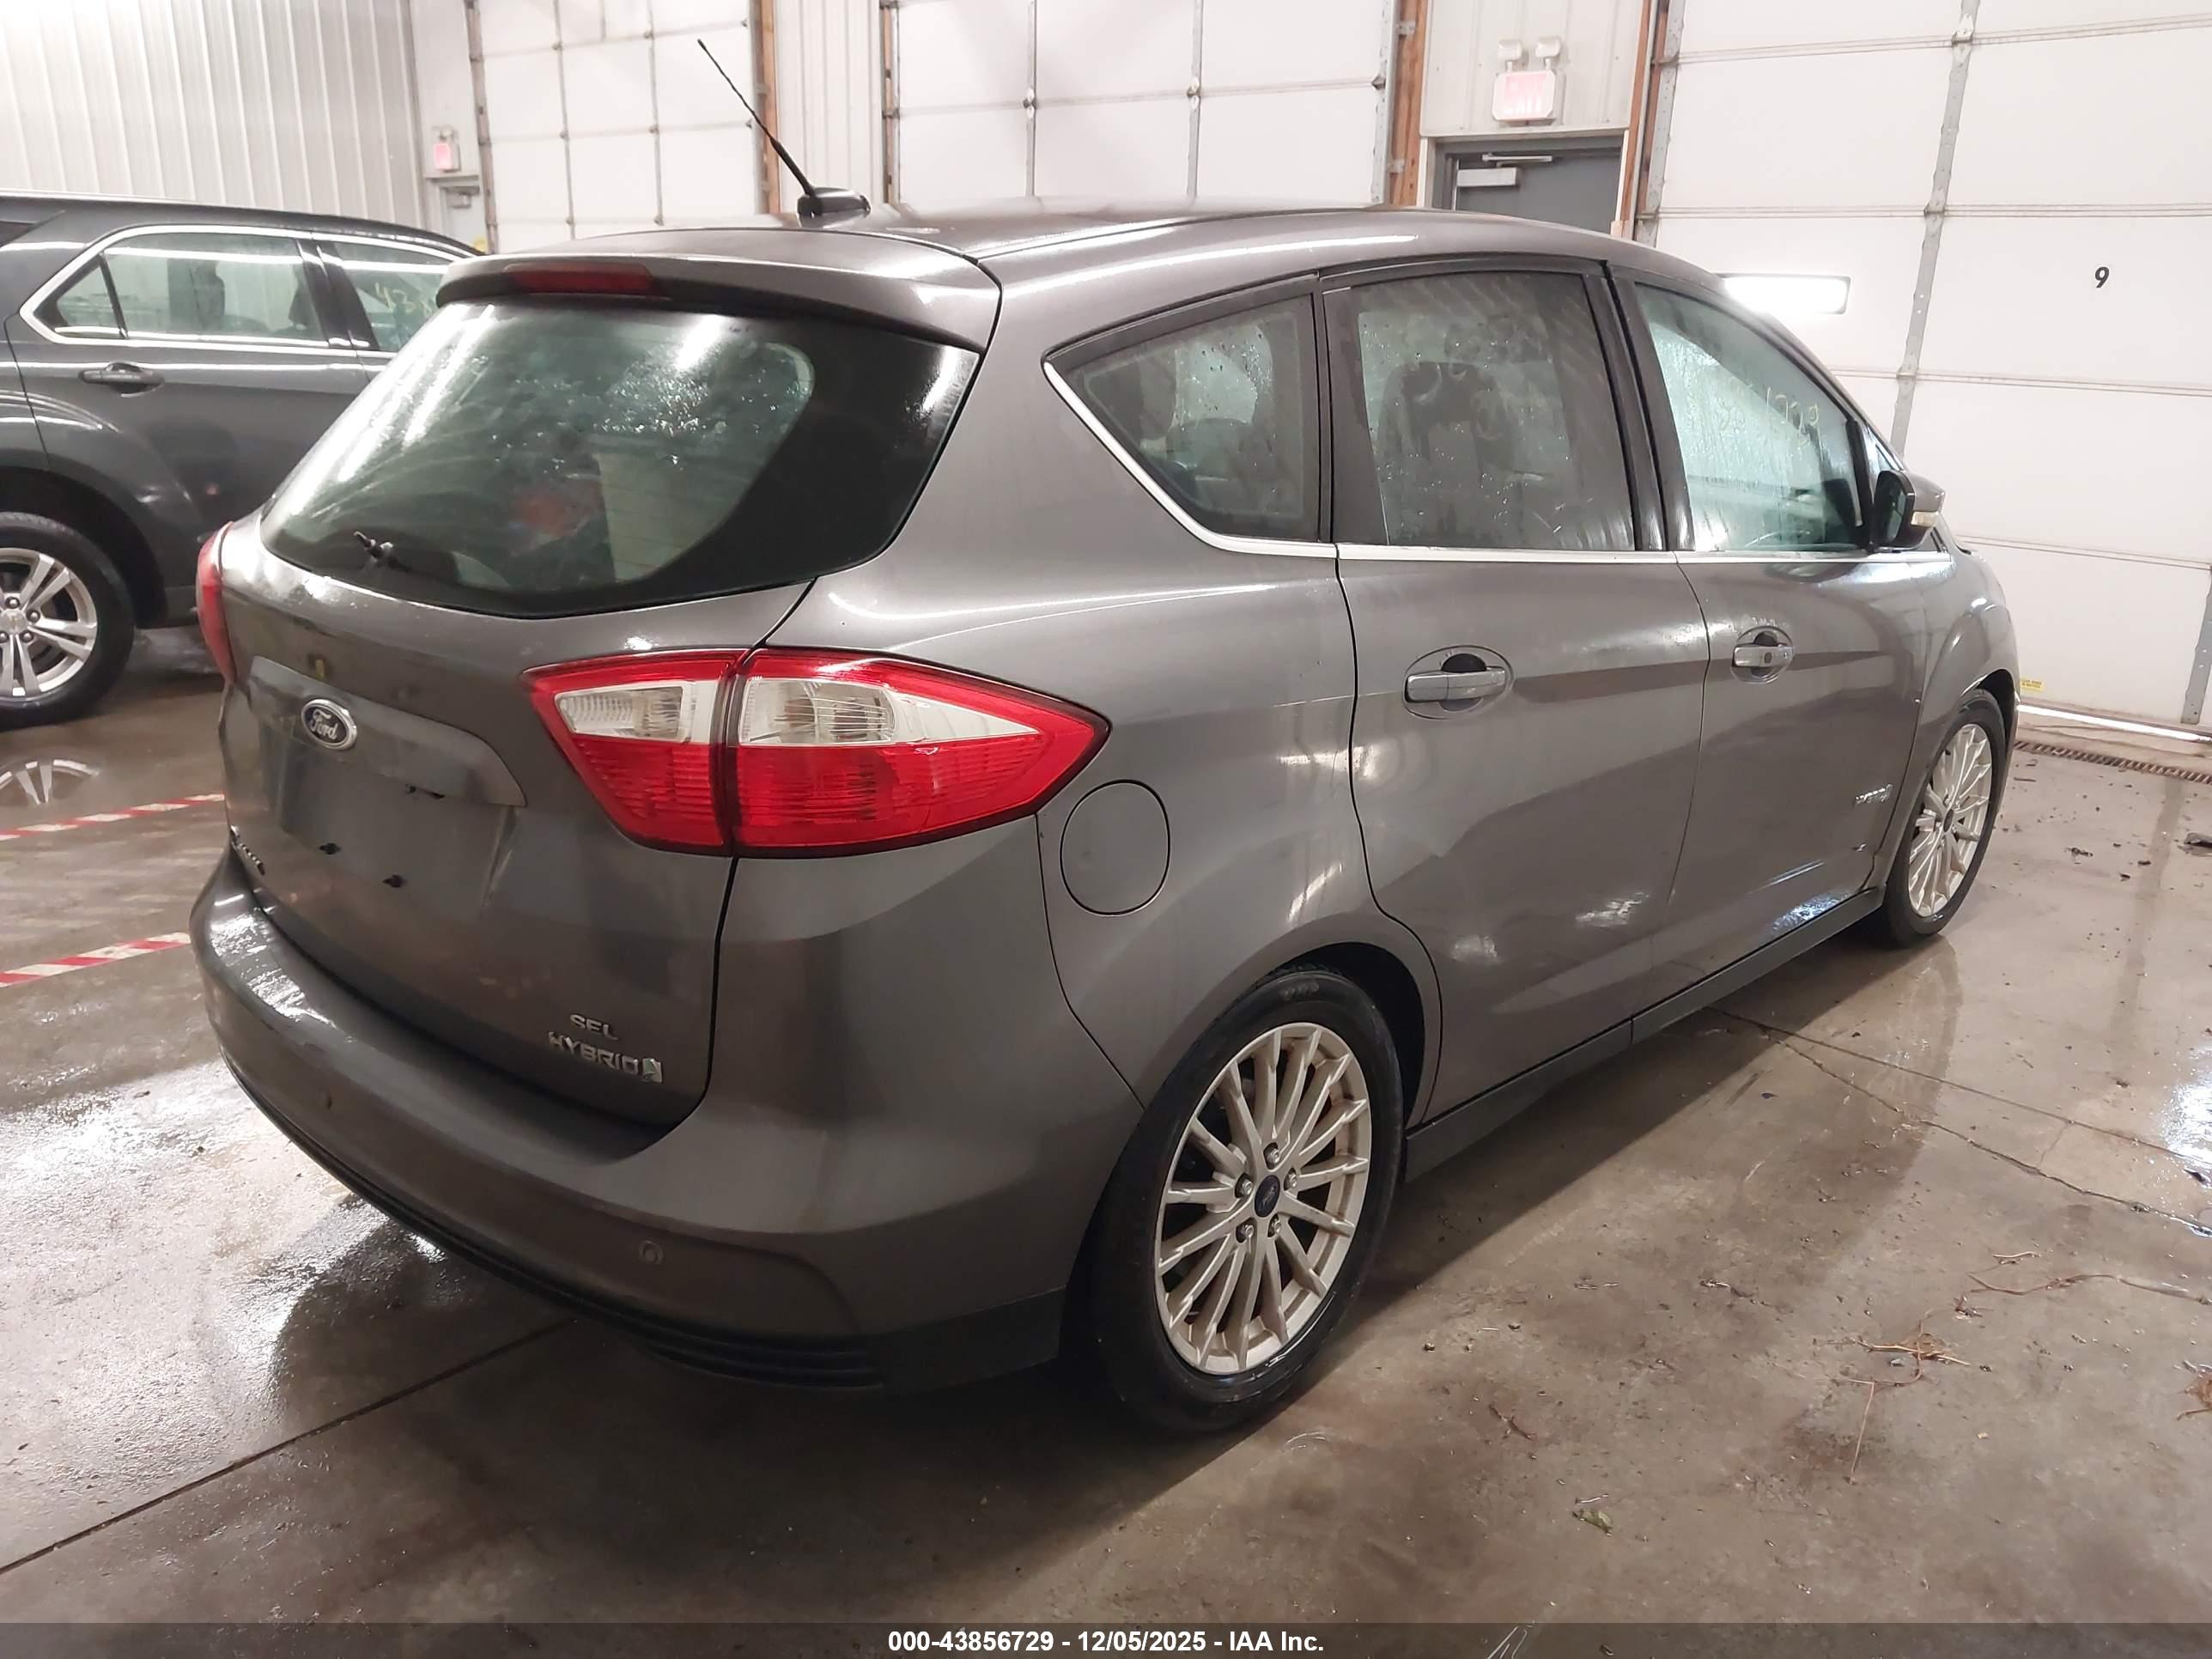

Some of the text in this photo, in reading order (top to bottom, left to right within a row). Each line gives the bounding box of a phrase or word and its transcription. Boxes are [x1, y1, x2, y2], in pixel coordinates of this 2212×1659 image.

[2094, 265, 2110, 289] 9
[309, 708, 339, 740] Ford
[569, 1012, 619, 1041] SEL
[547, 1031, 639, 1074] HYBRID
